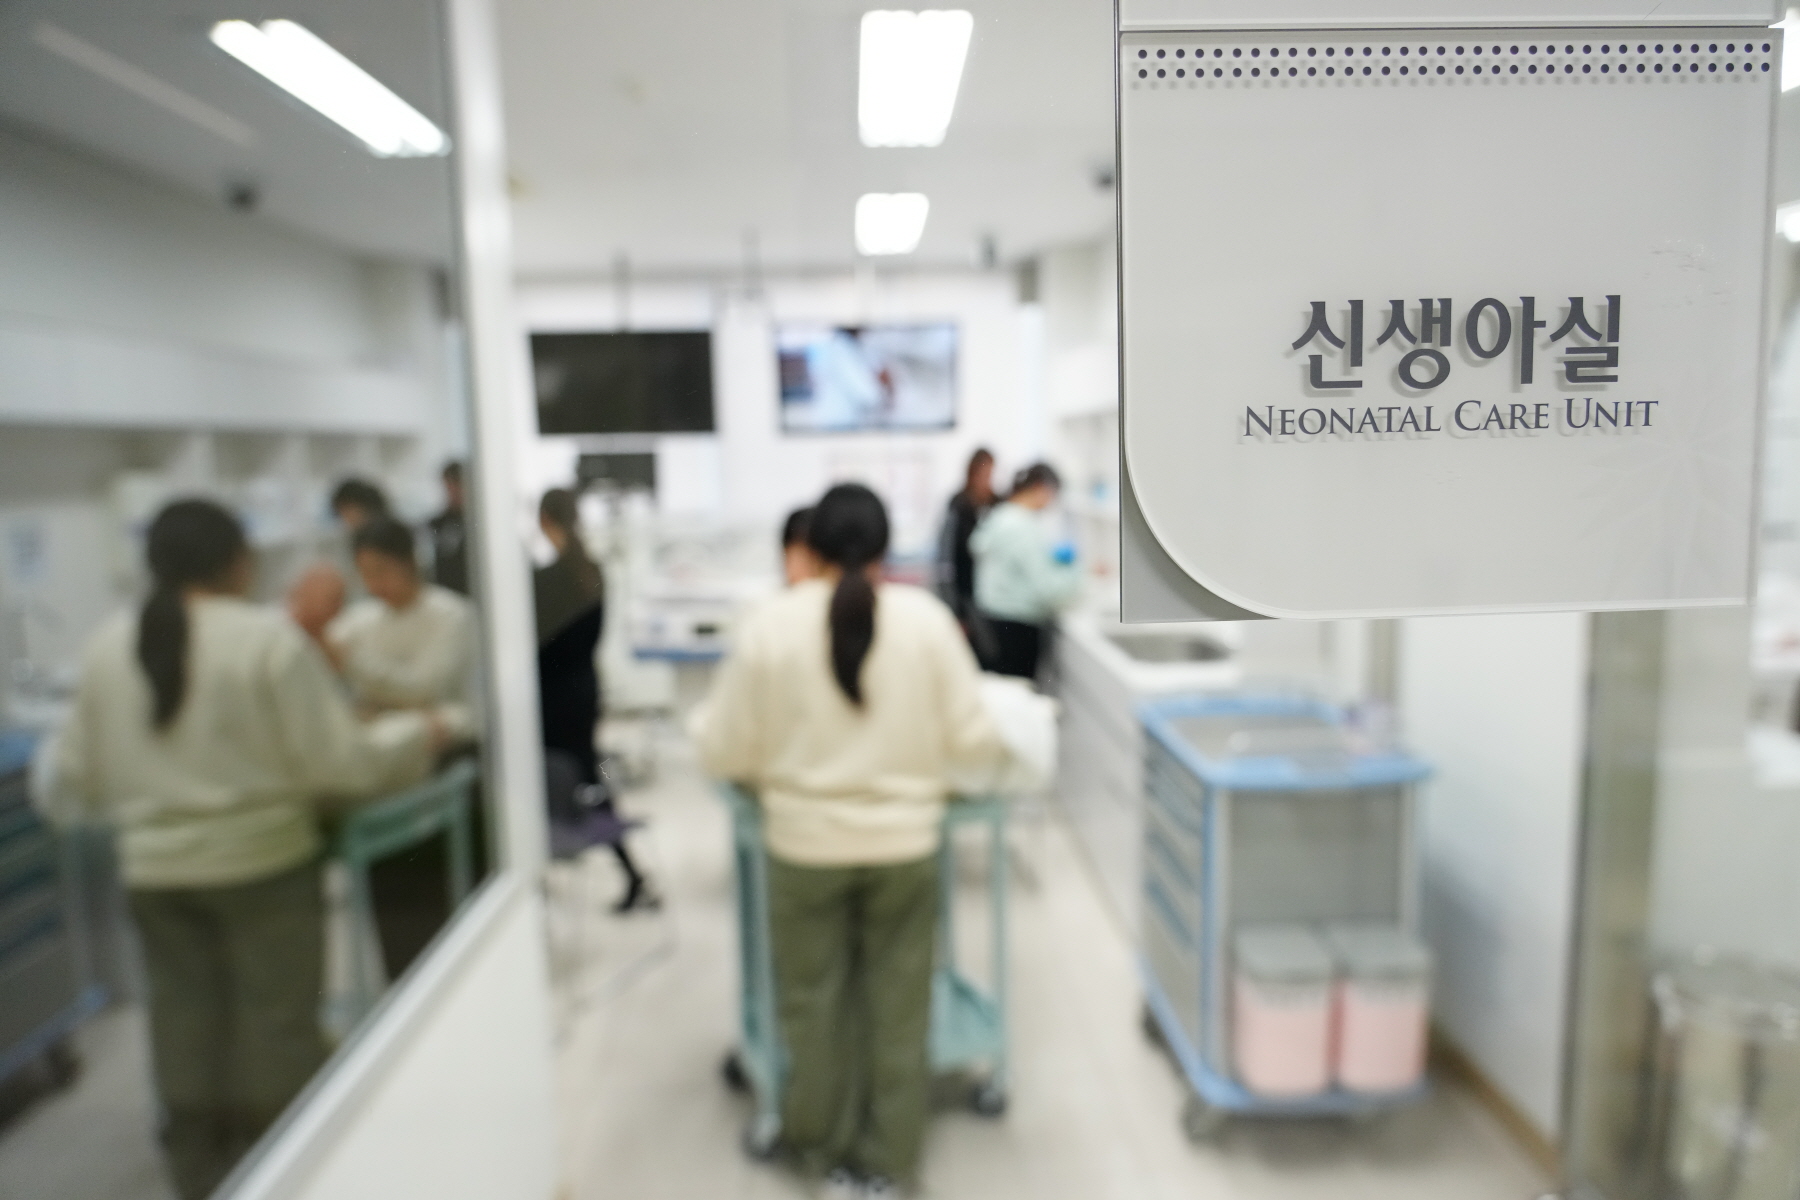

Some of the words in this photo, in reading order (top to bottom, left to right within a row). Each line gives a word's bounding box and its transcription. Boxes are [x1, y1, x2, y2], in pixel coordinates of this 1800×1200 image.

[1291, 294, 1621, 390] 신생아실
[1243, 405, 1442, 437] NEONATAL
[1454, 400, 1550, 431] CARE
[1564, 397, 1659, 429] UNIT
